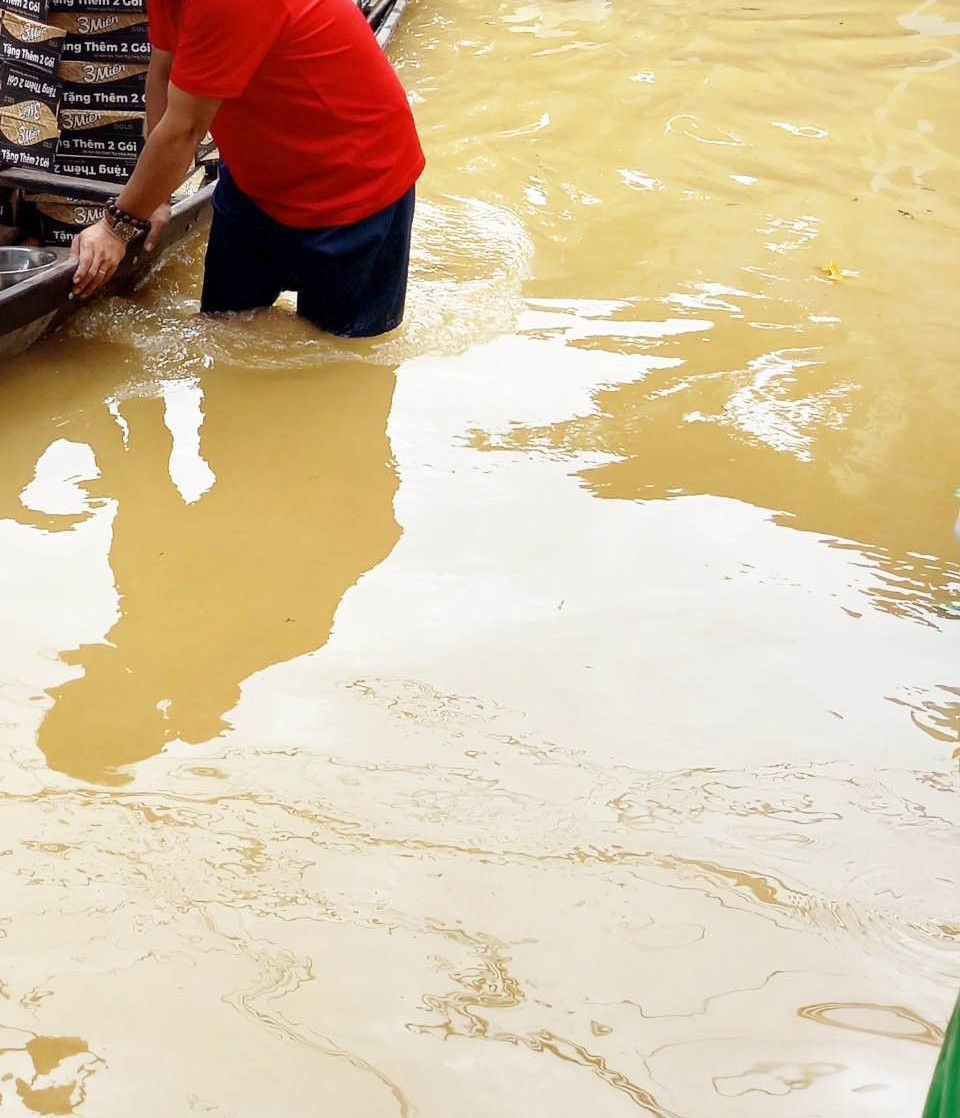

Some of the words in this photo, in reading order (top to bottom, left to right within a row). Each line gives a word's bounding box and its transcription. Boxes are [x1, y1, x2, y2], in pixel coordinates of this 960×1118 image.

[23, 0, 28, 9] 2
[29, 0, 41, 13] Gói
[84, 42, 118, 52] Thêm
[121, 43, 128, 52] 2
[131, 42, 151, 53] Gói
[2, 43, 20, 60] Tặng
[21, 47, 39, 63] Thêm
[40, 54, 44, 64] 2
[44, 56, 55, 68] Gói
[7, 74, 18, 86] Gói
[18, 78, 24, 88] 2
[24, 80, 41, 94] Thêm
[41, 82, 57, 98] Tặng
[63, 92, 91, 104] Tặng
[94, 92, 128, 103] Thêm
[131, 93, 139, 103] 2
[72, 139, 105, 149] Thêm
[107, 141, 115, 150] 2
[118, 141, 137, 152] Gói
[1, 149, 19, 164] Tặng
[19, 152, 36, 166] Thêm
[36, 156, 40, 165] 2
[40, 157, 50, 168] Gói
[54, 164, 61, 173] 2
[63, 164, 96, 176] Thêm
[99, 164, 129, 177] Tặng
